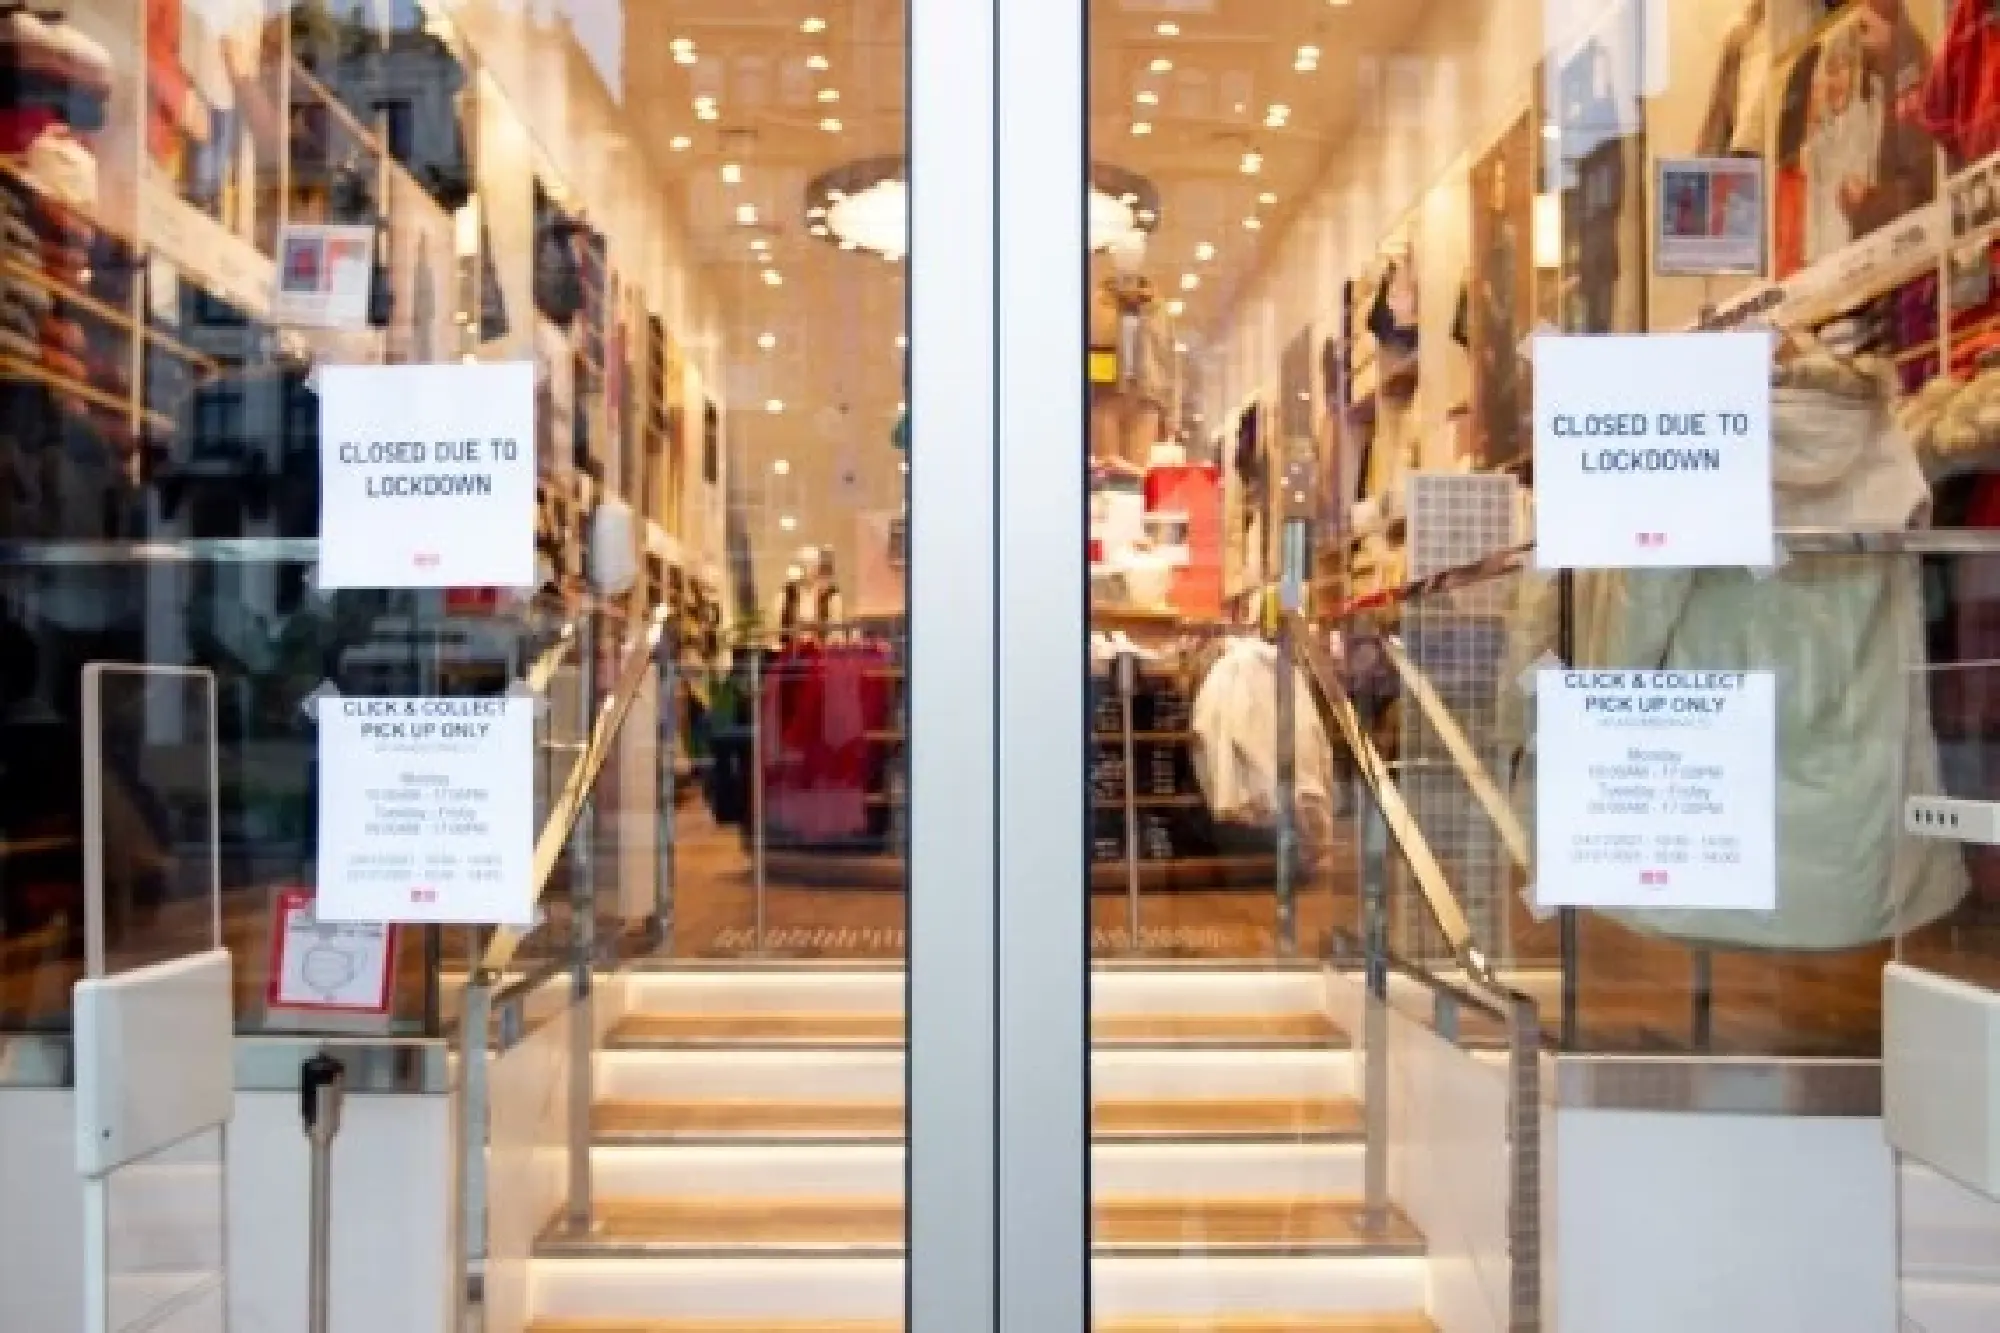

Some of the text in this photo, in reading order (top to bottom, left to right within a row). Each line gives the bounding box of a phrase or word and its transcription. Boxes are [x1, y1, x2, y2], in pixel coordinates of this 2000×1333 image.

[1552, 412, 1749, 437] CLOSED DUE TO
[339, 437, 518, 463] CLOSED DUE TO
[1581, 448, 1720, 473] LOCKDOWN
[365, 474, 492, 498] LOCKDOWN
[1564, 673, 1744, 690] CLICK & COLLECT
[343, 700, 507, 717] CLICK & COLLECT
[1585, 695, 1727, 713] PICK UP ONLY
[361, 722, 492, 738] PICK UP ONLY
